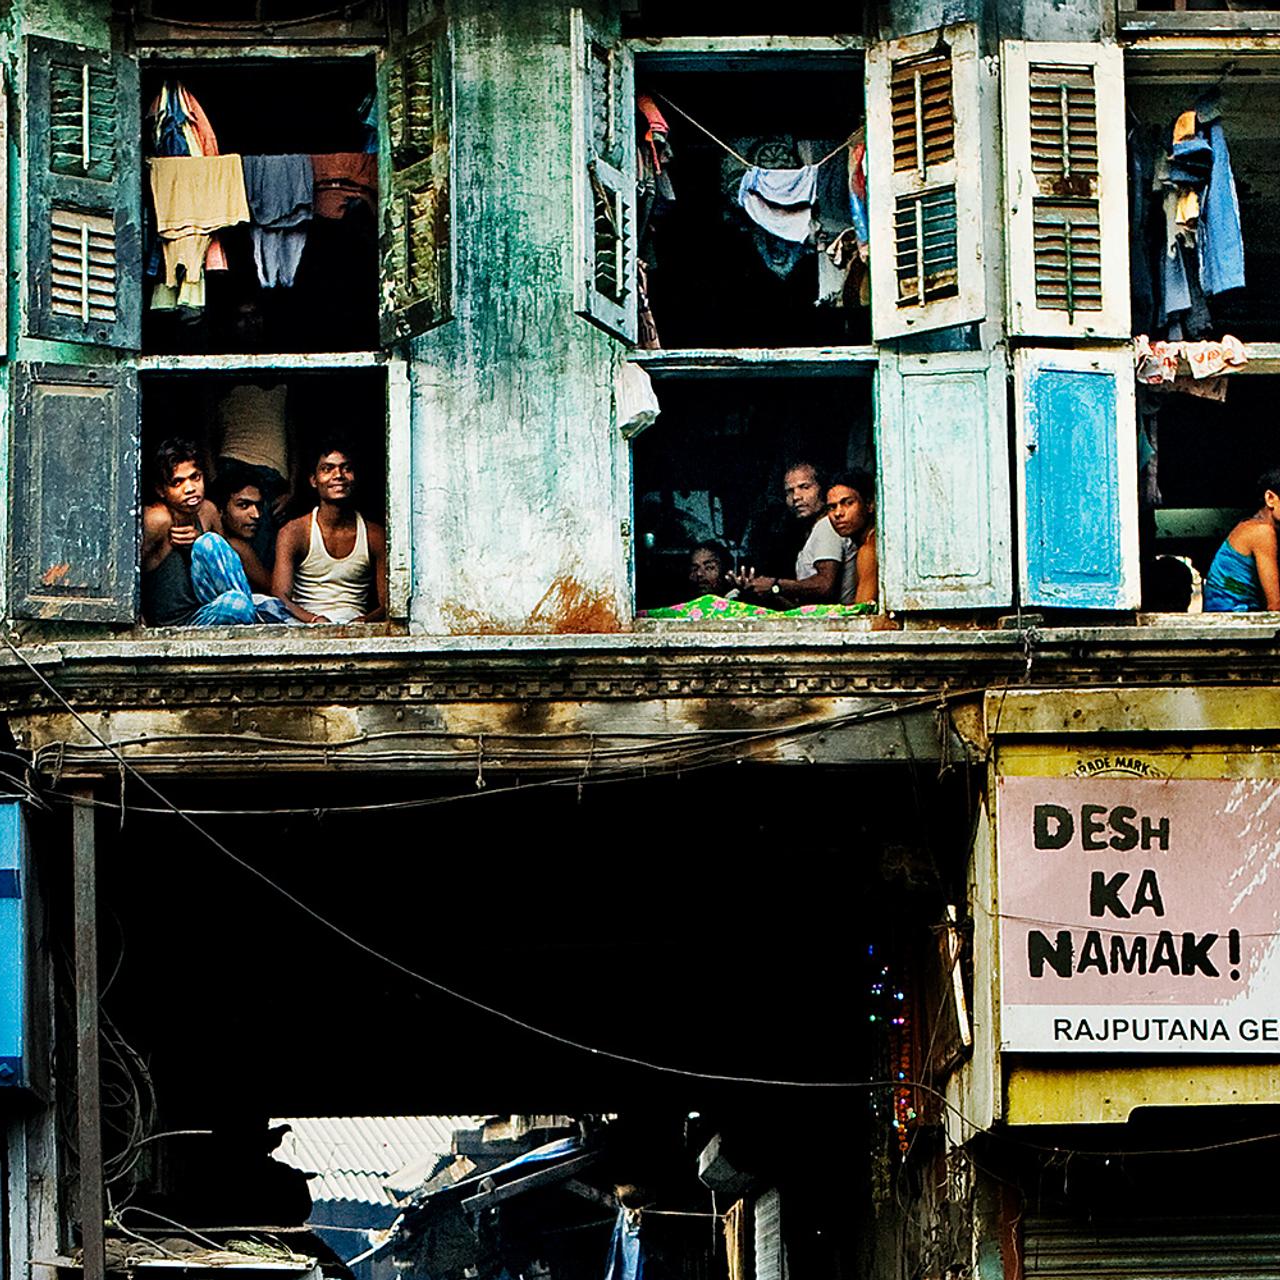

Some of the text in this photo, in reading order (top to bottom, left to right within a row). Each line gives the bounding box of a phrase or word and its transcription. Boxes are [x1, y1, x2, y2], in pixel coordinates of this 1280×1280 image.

[1115, 757, 1150, 776] MARK
[1033, 803, 1170, 851] DESH
[1089, 869, 1165, 919] KA
[1027, 928, 1240, 981] NAMAK!
[1054, 1018, 1230, 1042] RAJPUTANA
